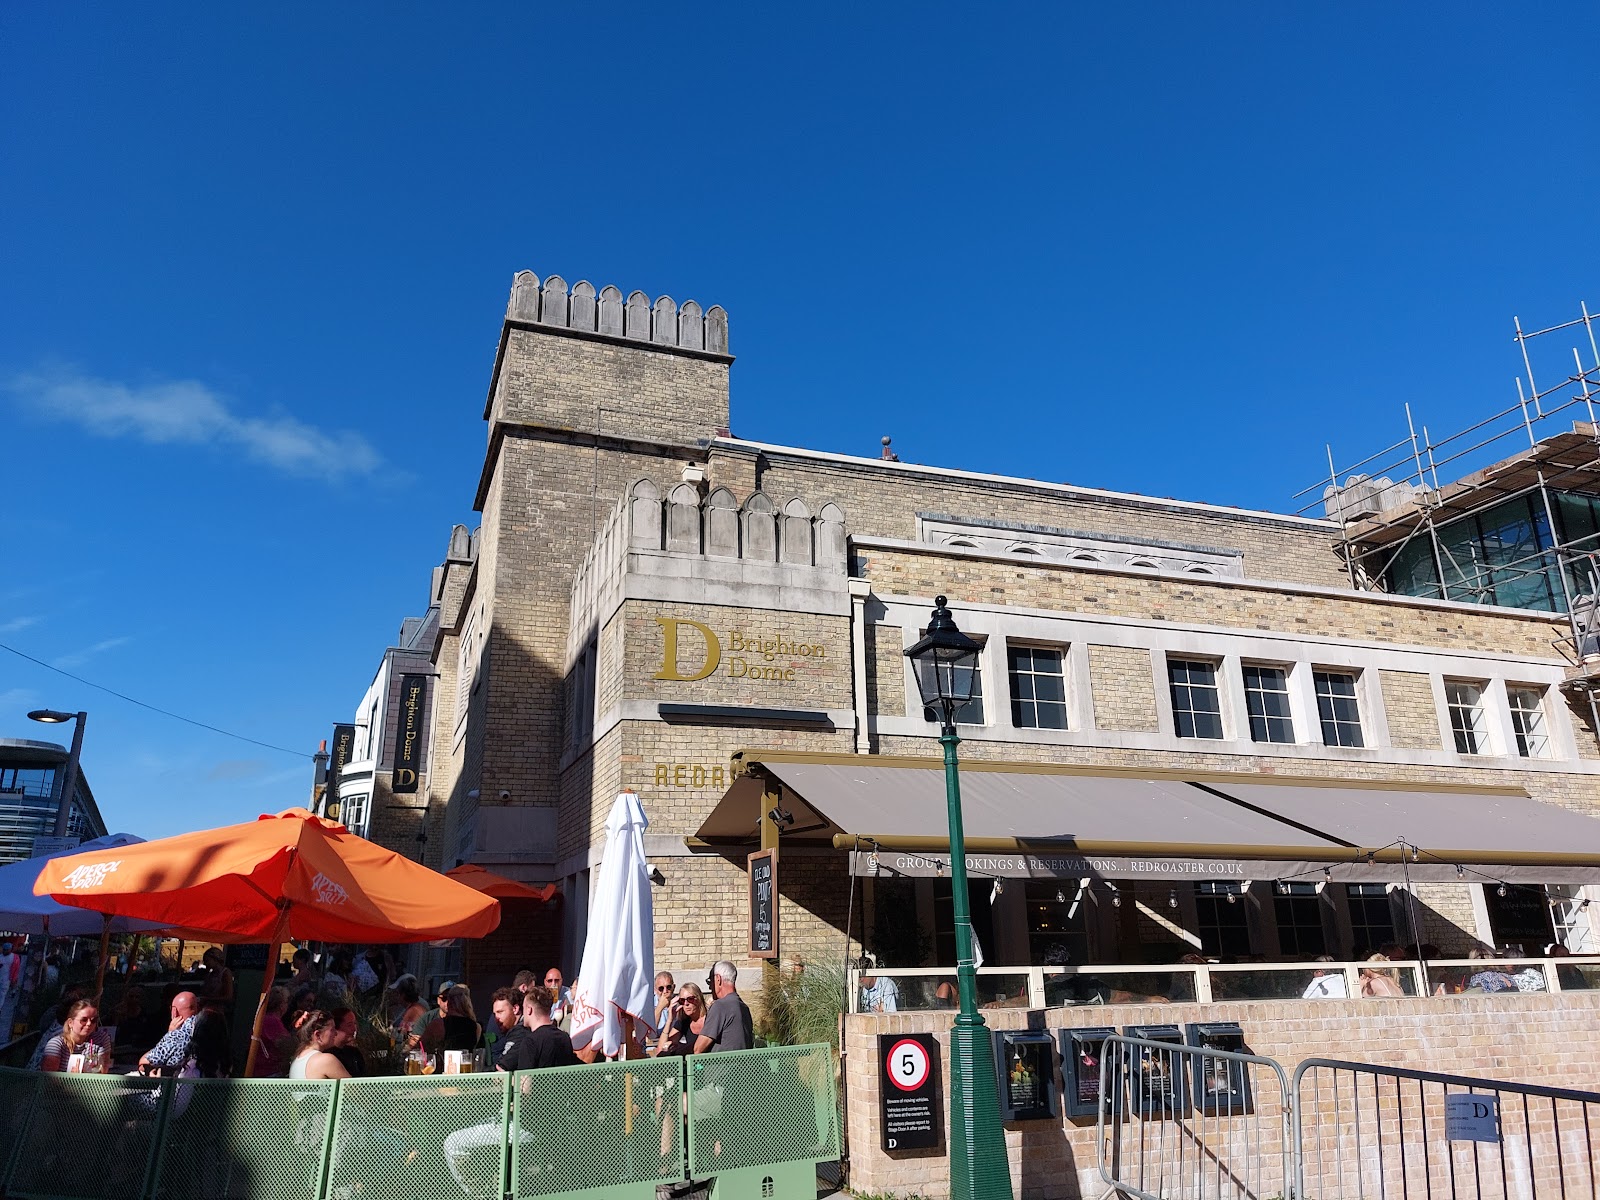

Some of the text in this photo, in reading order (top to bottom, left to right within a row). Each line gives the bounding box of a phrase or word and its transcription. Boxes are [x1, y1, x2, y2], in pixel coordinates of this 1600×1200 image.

[653, 617, 722, 682] D
[727, 630, 826, 662] Brighton
[727, 656, 796, 681] Dome
[403, 687, 421, 761] Brighton Dome
[336, 734, 350, 770] Brighton
[396, 769, 416, 786] D
[655, 764, 735, 789] REDR
[61, 860, 122, 883] APEROL
[1017, 859, 1026, 870] &
[1030, 859, 1127, 872] RESERVATIONS...
[1131, 861, 1243, 874] REDROASTER.CO.UK
[65, 873, 107, 890] SPRITZ
[902, 1054, 915, 1076] 5
[1472, 1102, 1489, 1118] D
[888, 1139, 897, 1148] D
